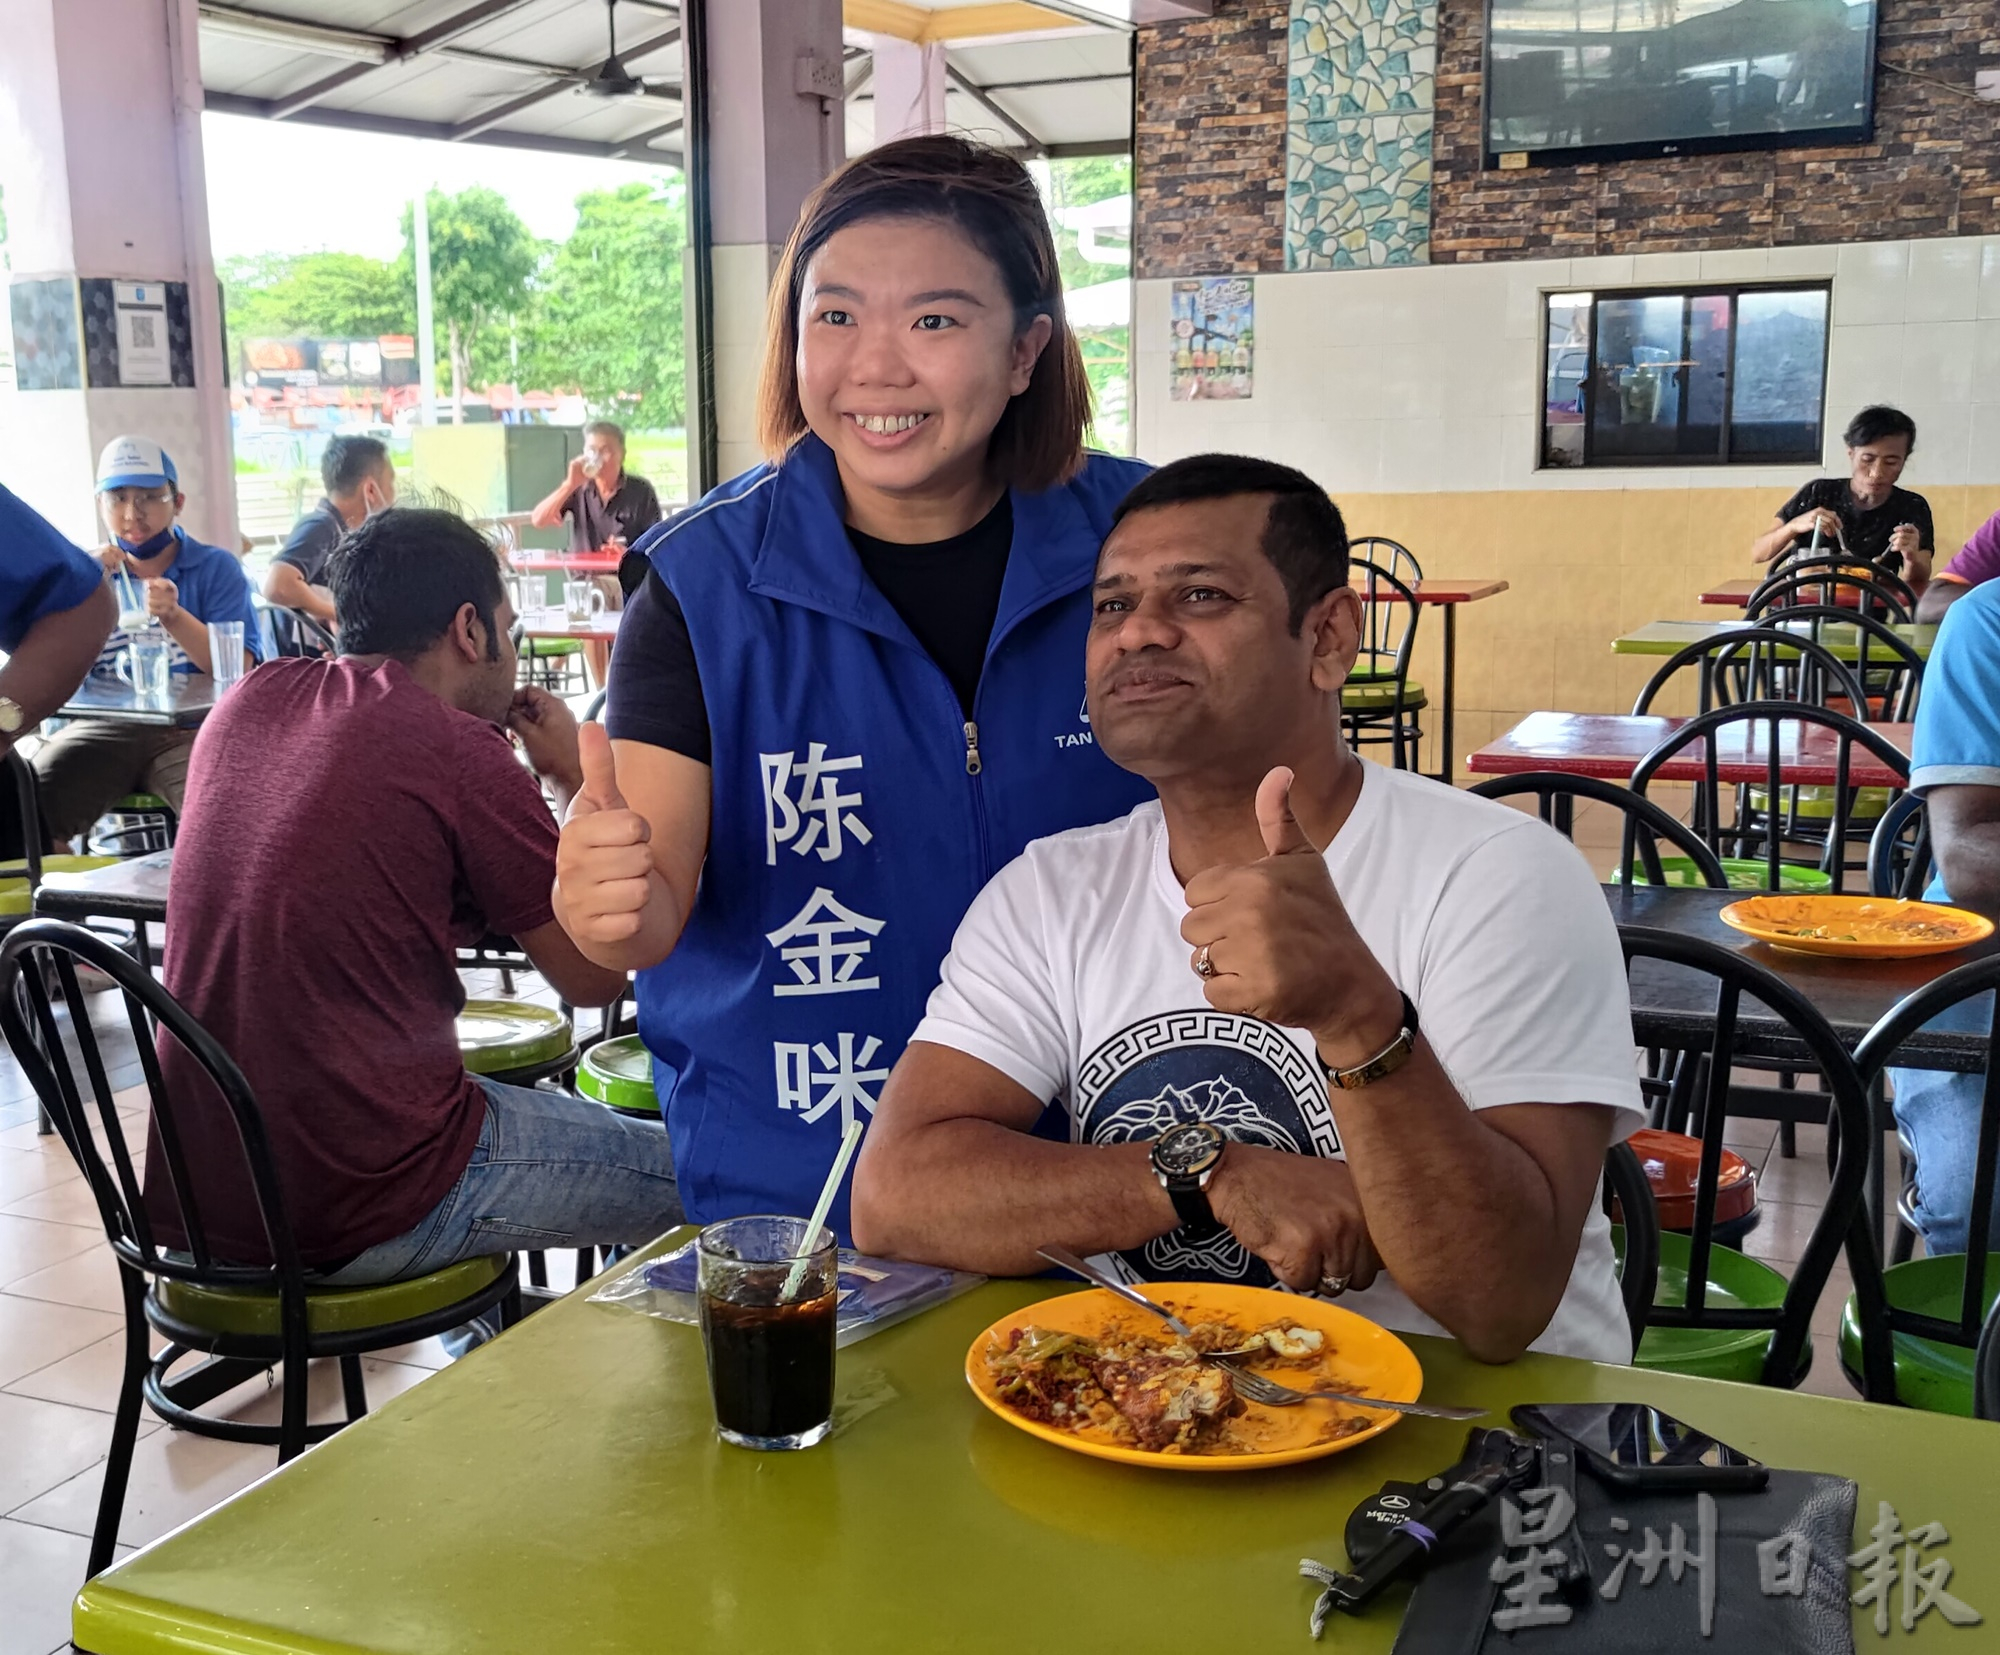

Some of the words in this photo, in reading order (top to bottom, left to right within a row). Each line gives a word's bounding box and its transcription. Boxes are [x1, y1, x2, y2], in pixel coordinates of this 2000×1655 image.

[1054, 731, 1093, 749] TAN
[759, 742, 889, 1138] 陈金咪
